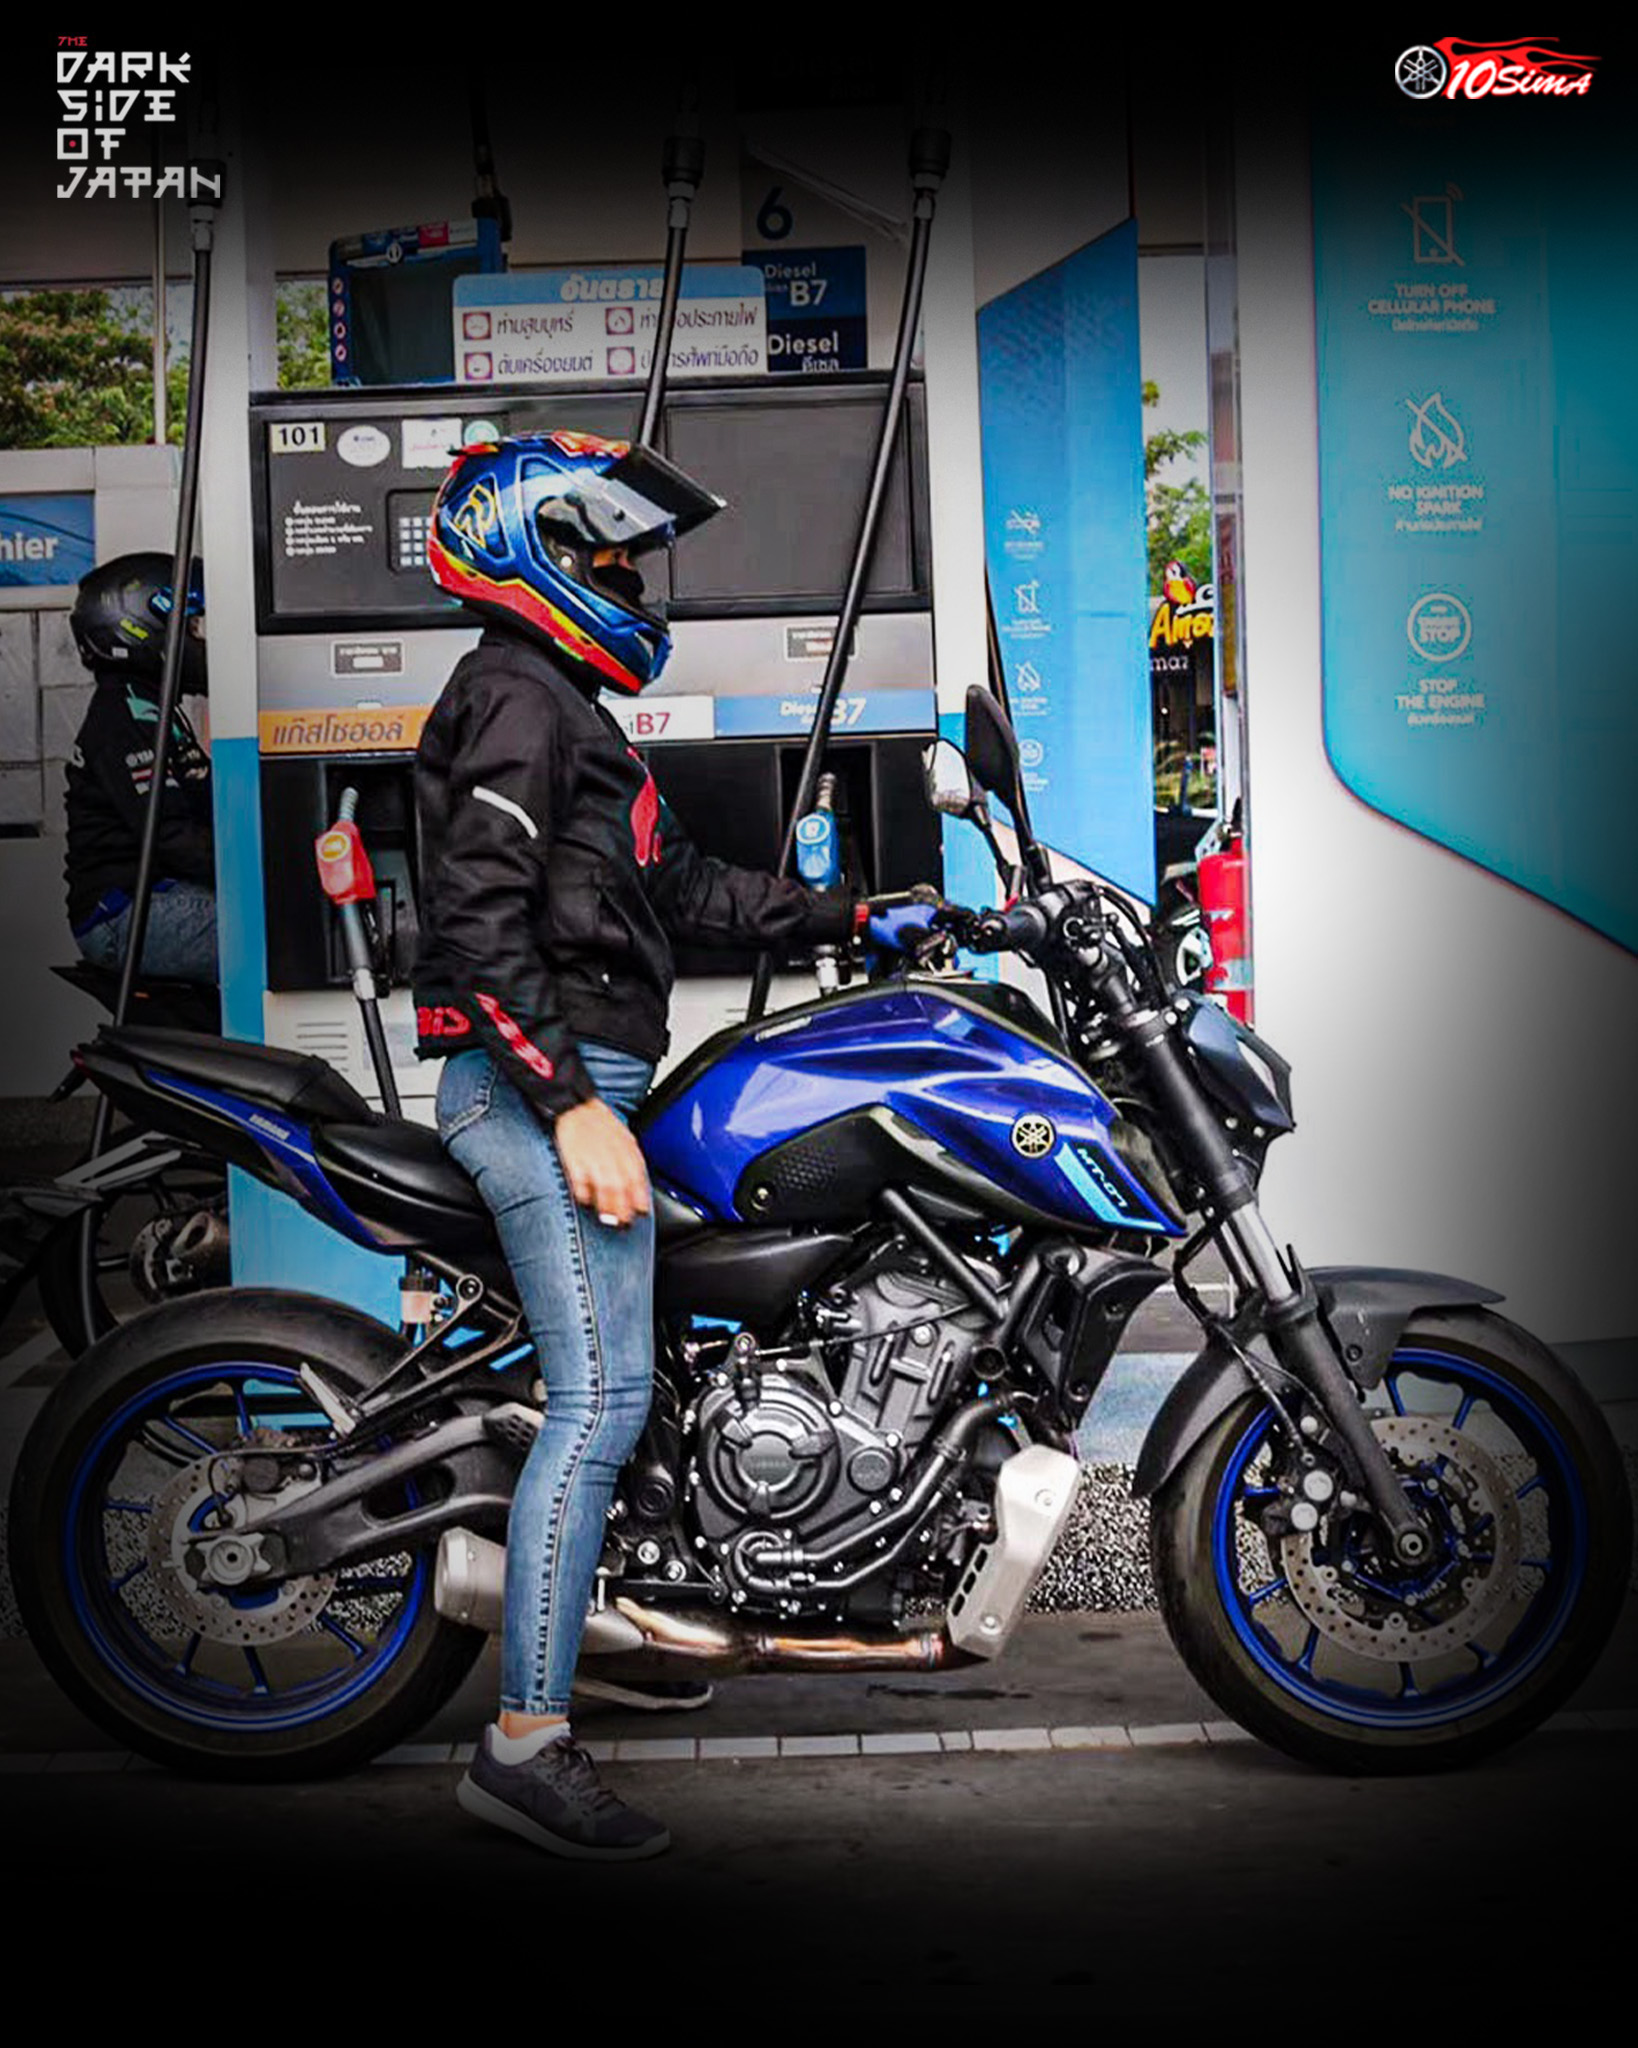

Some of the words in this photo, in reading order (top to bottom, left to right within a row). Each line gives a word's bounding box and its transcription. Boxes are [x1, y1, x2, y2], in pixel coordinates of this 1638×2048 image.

[757, 186, 793, 240] 6
[764, 262, 817, 279] Diesel
[789, 278, 828, 307] B7
[767, 330, 840, 356] Diesel
[279, 426, 320, 447] 101
[1419, 679, 1458, 694] STOP
[1397, 694, 1425, 709] THE
[1427, 693, 1485, 709] ENGINE
[636, 712, 671, 736] B7
